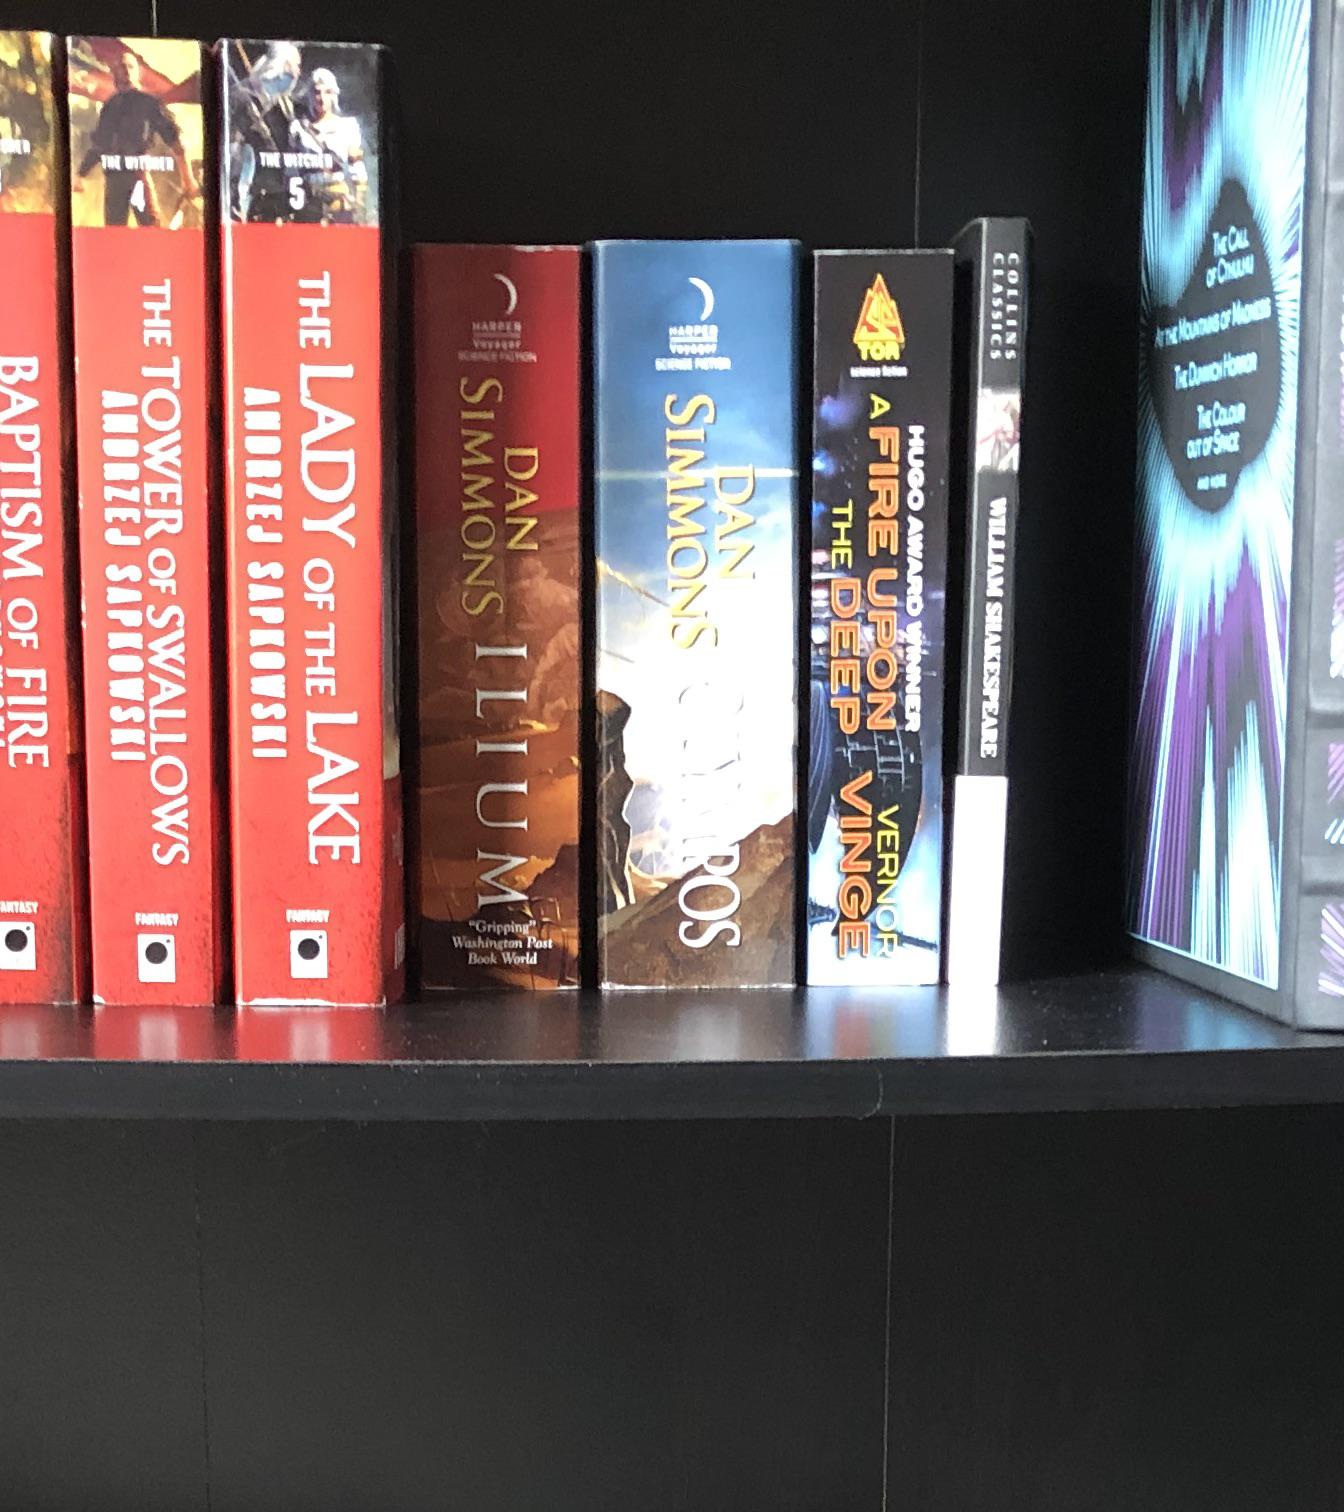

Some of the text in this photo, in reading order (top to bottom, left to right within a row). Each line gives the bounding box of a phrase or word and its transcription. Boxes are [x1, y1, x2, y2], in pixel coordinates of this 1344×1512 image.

[129, 180, 146, 214] 4
[288, 176, 305, 210] 5
[989, 252, 1004, 360] CLASSICS
[1004, 252, 1020, 360] COLLINS
[869, 393, 891, 420] A
[459, 376, 539, 618] DAN SIMMONS
[664, 393, 757, 649] DAN SIMMONS
[867, 425, 900, 557] FIRE
[6, 597, 40, 648] OF
[141, 278, 190, 866] THE TOWER OF SWALLOWS
[297, 271, 361, 866] THE LADY OF THE LAKE
[830, 499, 861, 735] THE DEEP
[905, 424, 926, 732] HUGO AWARD WINNER
[980, 497, 1008, 759] WILLIAM SHAKESPEARE
[6, 666, 49, 769] FIRE
[866, 567, 898, 731] UPON
[474, 643, 530, 911] ILIUM
[837, 770, 874, 959] VINGE
[875, 804, 900, 957] VERNOR
[452, 935, 553, 950] Washington Post
[467, 951, 537, 965] Book World
